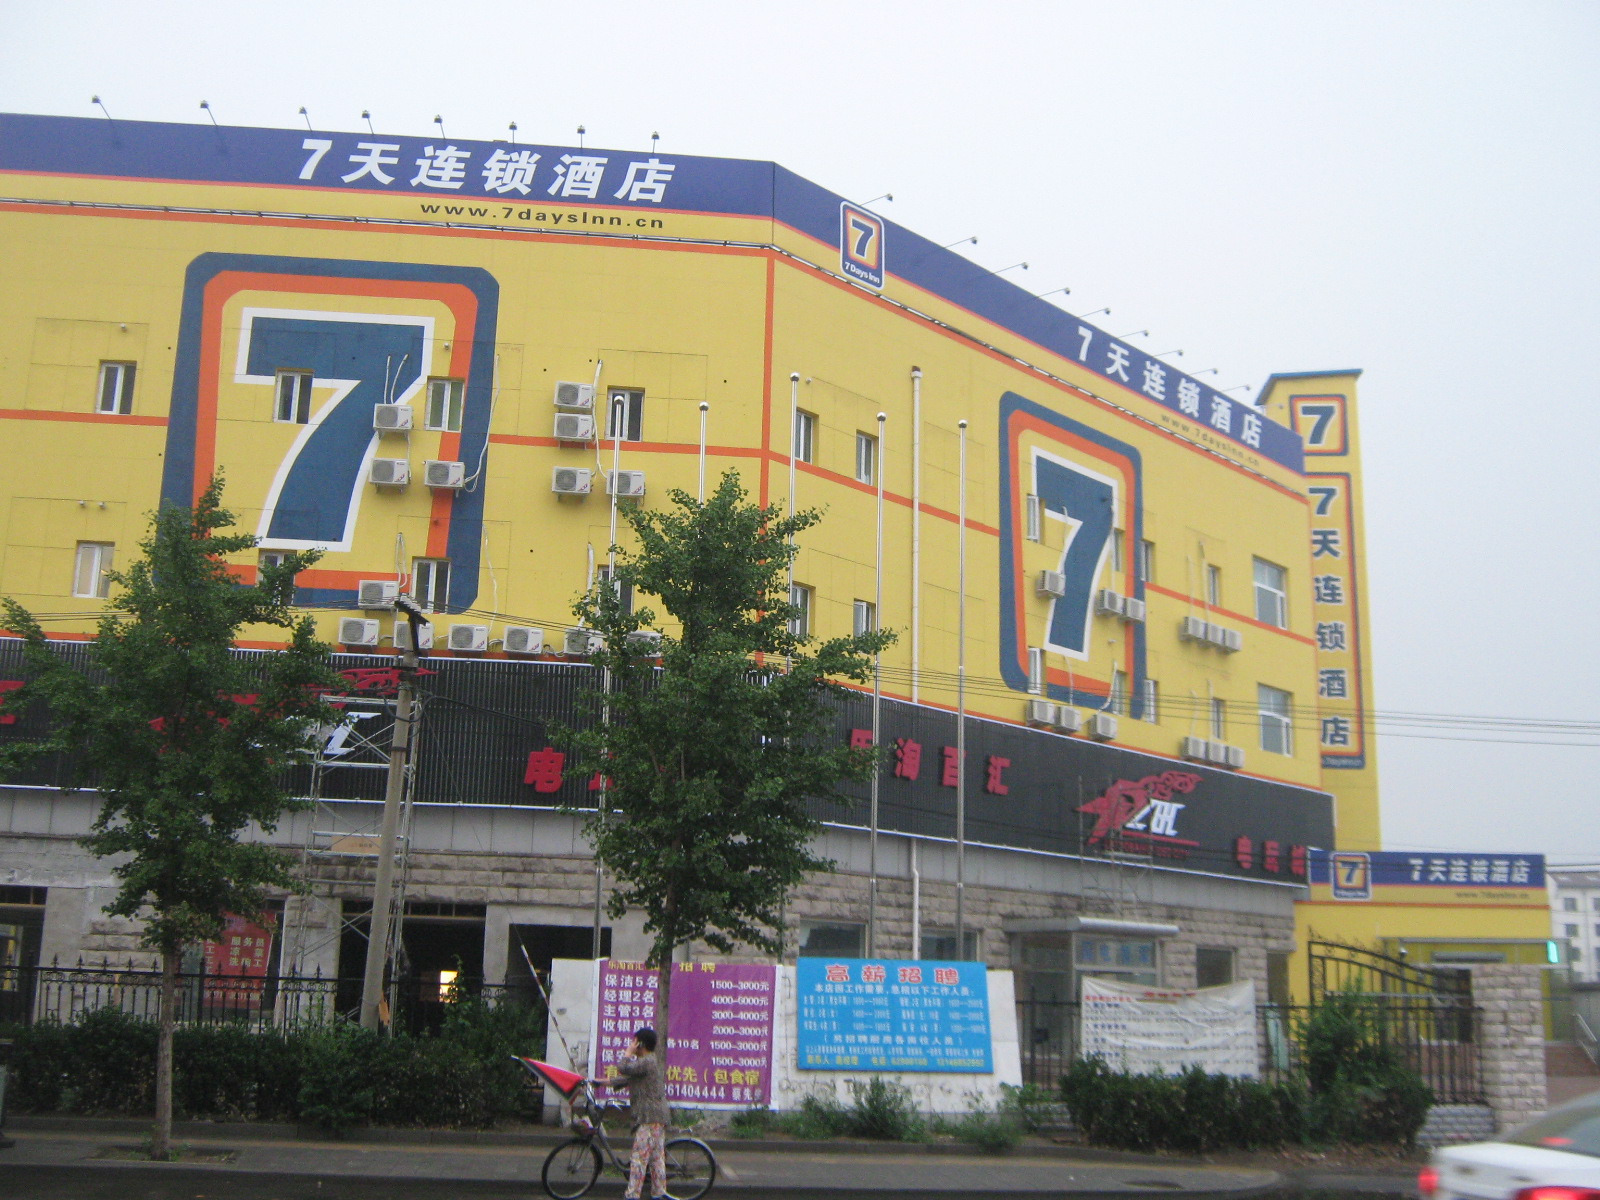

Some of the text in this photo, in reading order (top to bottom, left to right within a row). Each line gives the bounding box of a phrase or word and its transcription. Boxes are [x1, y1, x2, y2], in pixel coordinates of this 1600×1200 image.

[298, 138, 676, 203] 7天连锁酒店
[851, 216, 875, 259] 7
[850, 264, 868, 279] Days
[1078, 326, 1262, 448] 7天连锁酒店
[234, 307, 435, 552] 7
[1301, 404, 1335, 445] 7
[1030, 445, 1119, 662] 7
[1308, 487, 1350, 746] 7天连锁酒店
[1341, 861, 1359, 885] 7
[605, 973, 659, 989] 保洁5名
[825, 964, 960, 986] 高薪招聘
[603, 1003, 654, 1018] 主管3名
[604, 988, 654, 1003] 经理2名
[664, 1083, 725, 1099] 61404444
